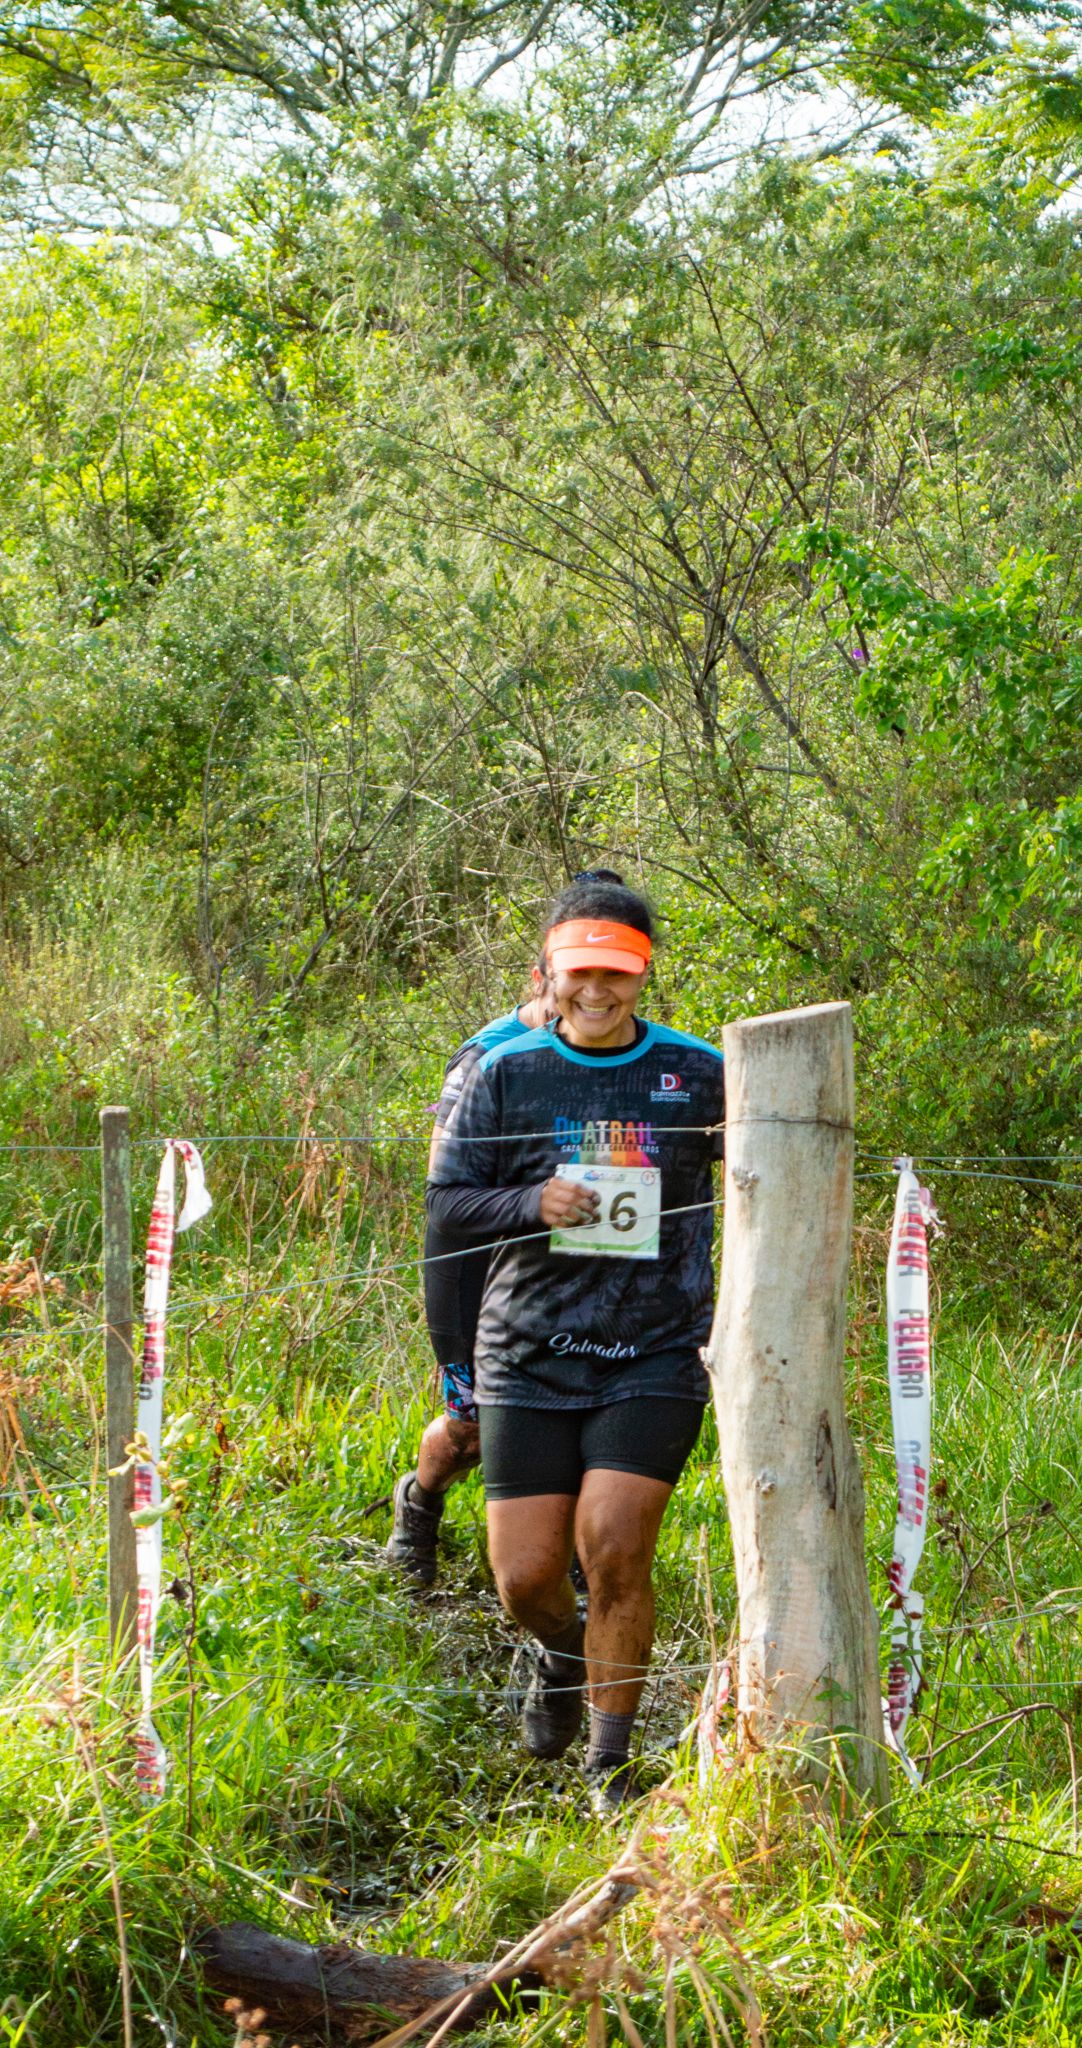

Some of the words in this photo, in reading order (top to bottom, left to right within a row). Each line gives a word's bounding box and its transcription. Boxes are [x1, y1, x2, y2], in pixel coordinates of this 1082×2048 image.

[554, 1116, 657, 1145] DUATRAIL
[548, 1332, 640, 1359] Salvador
[898, 1309, 925, 1398] PELIGRO
